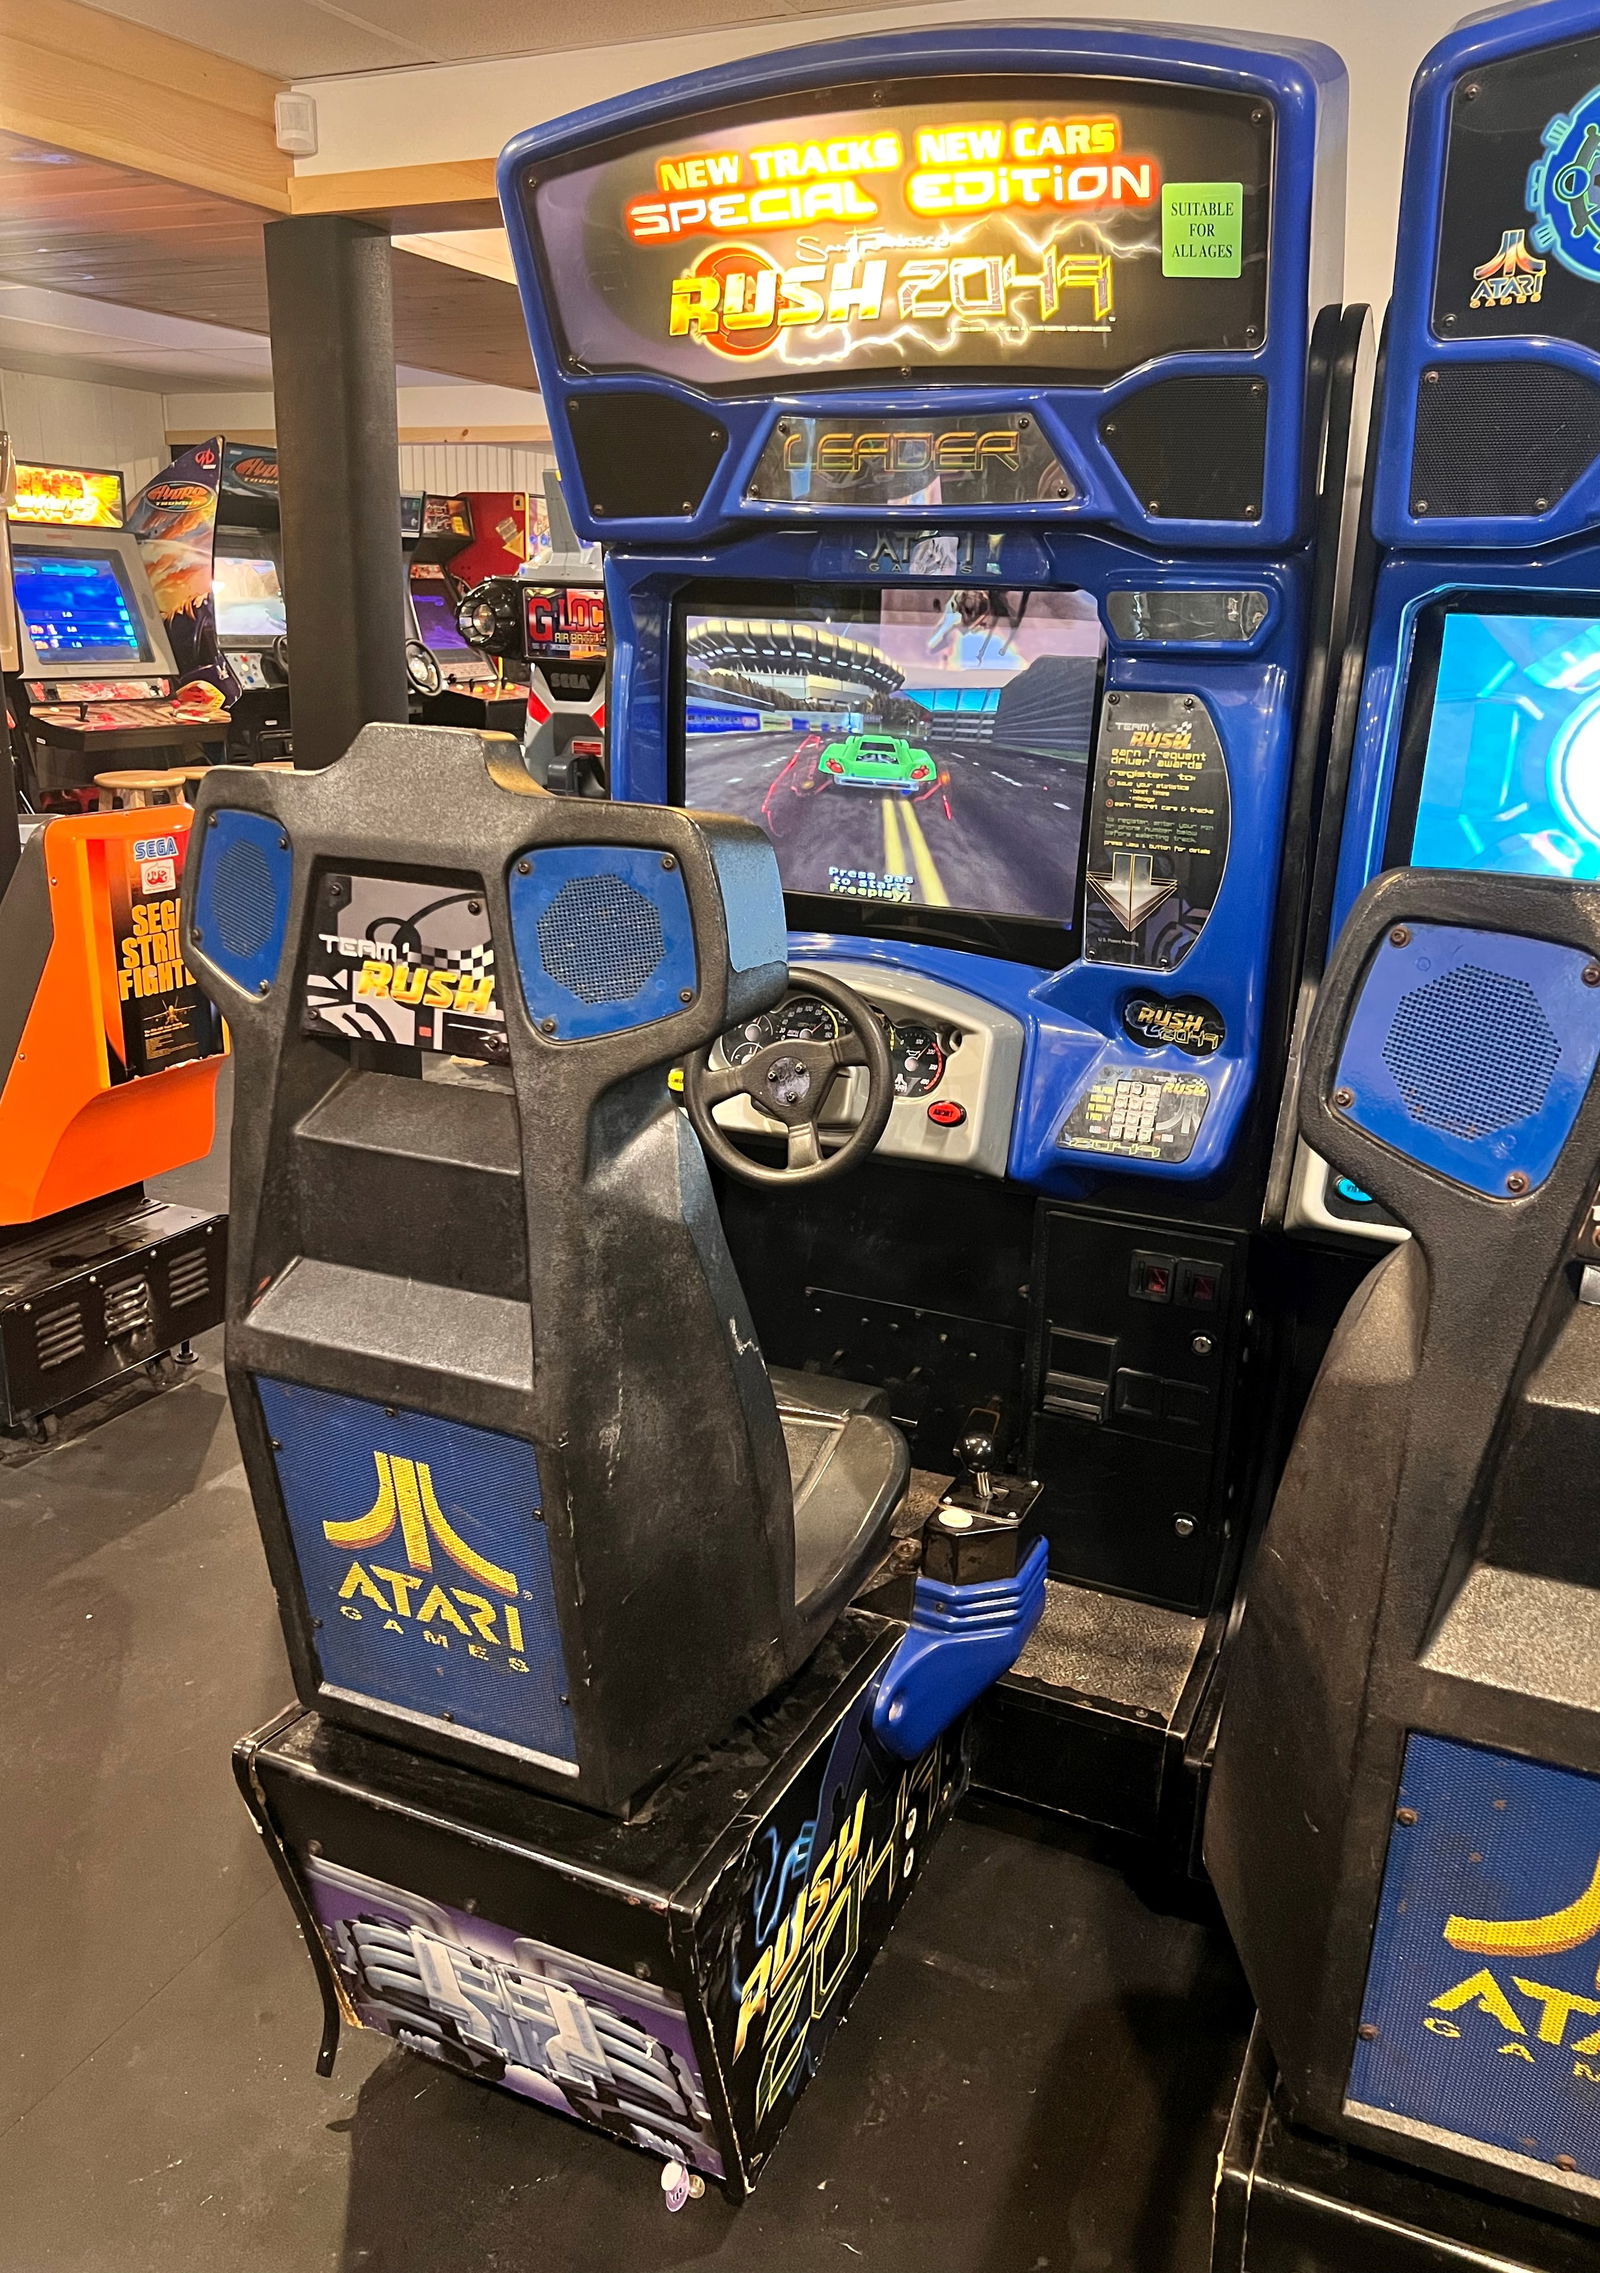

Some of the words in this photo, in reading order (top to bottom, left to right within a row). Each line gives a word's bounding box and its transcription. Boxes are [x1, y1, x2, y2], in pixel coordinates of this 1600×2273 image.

[660, 158, 741, 192] NEW
[751, 133, 898, 179] TRACKS
[920, 129, 1002, 165] NEW
[1014, 122, 1117, 156] CARS
[630, 182, 877, 235] SPECIAL
[1171, 202, 1234, 216] SUITABLE
[1189, 223, 1215, 237] FOR
[1172, 244, 1198, 258] ALL
[1199, 244, 1233, 258] AGES
[670, 261, 887, 338] RUSH
[898, 246, 1113, 322] 2049
[1470, 274, 1544, 300] ATARI
[783, 431, 1020, 472] LEADER
[550, 672, 591, 689] SEGA
[1114, 721, 1150, 731] TEAM
[1129, 731, 1192, 750] RUSH
[1110, 756, 1150, 766] driver
[1156, 759, 1203, 770] awards
[1111, 748, 1142, 758] earn
[1148, 749, 1207, 762] frequent
[1109, 769, 1170, 779] register
[135, 838, 178, 861] SEGA
[828, 866, 876, 880] Press
[883, 874, 914, 884] gas
[833, 875, 852, 886] to
[318, 933, 398, 962] TEAM
[358, 960, 496, 1014] RUSH
[1137, 1006, 1205, 1032] RUSH
[1162, 1082, 1207, 1097] RUSH
[338, 1561, 525, 1653] ATARI
[339, 1605, 530, 1673] GAMES
[731, 1788, 868, 2066] RUSH
